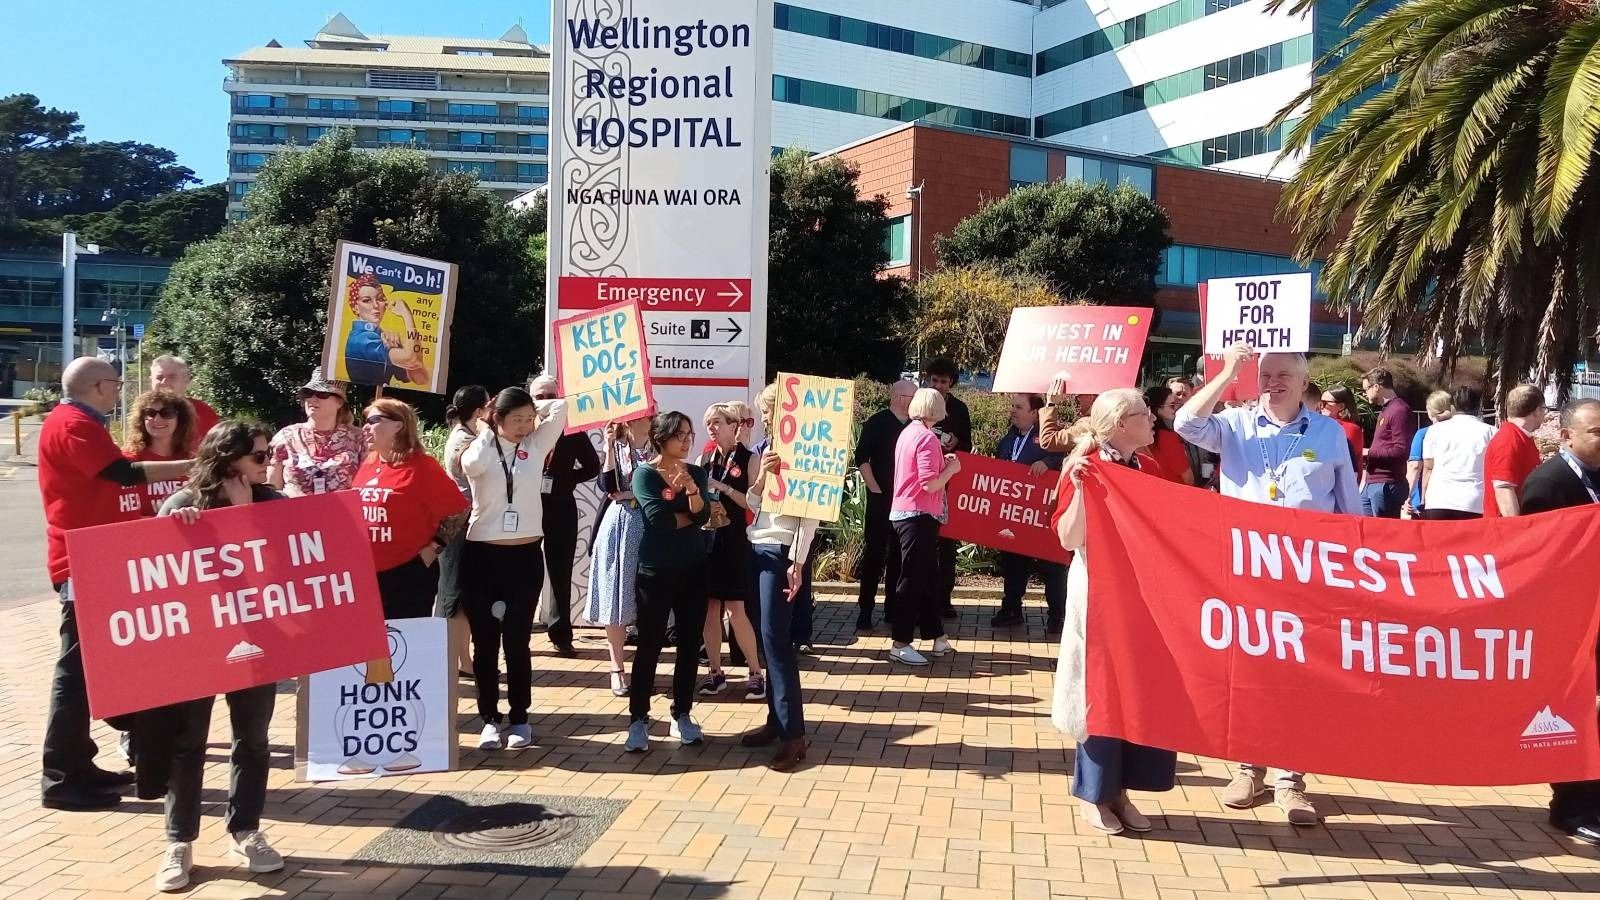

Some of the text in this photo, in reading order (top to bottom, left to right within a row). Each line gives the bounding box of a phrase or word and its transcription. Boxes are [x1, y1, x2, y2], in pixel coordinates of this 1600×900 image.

[568, 17, 750, 56] Wellington
[586, 66, 733, 106] Regional
[576, 117, 742, 148] HOSPITAL
[567, 188, 741, 206] NGA PUNA WAI ORA
[351, 255, 442, 289] We Can't Do It!
[416, 297, 434, 308] any
[597, 282, 706, 306] Emergency
[1235, 280, 1281, 301] TOOT
[412, 308, 440, 321] more,
[422, 320, 431, 331] Te
[1239, 304, 1274, 325] FOR
[407, 330, 438, 344] Whatu
[572, 312, 628, 352] KEEP
[650, 322, 686, 336] Suite
[1034, 323, 1123, 341] NVEST IN
[1222, 327, 1291, 349] HEALTH
[413, 344, 430, 355] Ora
[582, 343, 638, 379] DOCs
[655, 355, 715, 370] Entrance
[1023, 345, 1130, 364] UR HEALTH
[576, 372, 642, 413] in NZ
[782, 376, 848, 412] SAVE
[779, 414, 833, 445] OUR
[793, 441, 847, 463] PUBLIC
[794, 457, 845, 477] HEALTH
[971, 473, 1036, 501] INVEST
[957, 493, 1049, 529] OUR HEAL
[126, 530, 326, 594] INVEST IN
[1230, 527, 1505, 599] INVEST IN
[108, 571, 356, 647] OUR HEALTH
[1200, 598, 1534, 681] OUR HEALTH
[340, 679, 422, 706] HONK
[353, 706, 408, 731] FOR
[343, 730, 418, 757] DOCS
